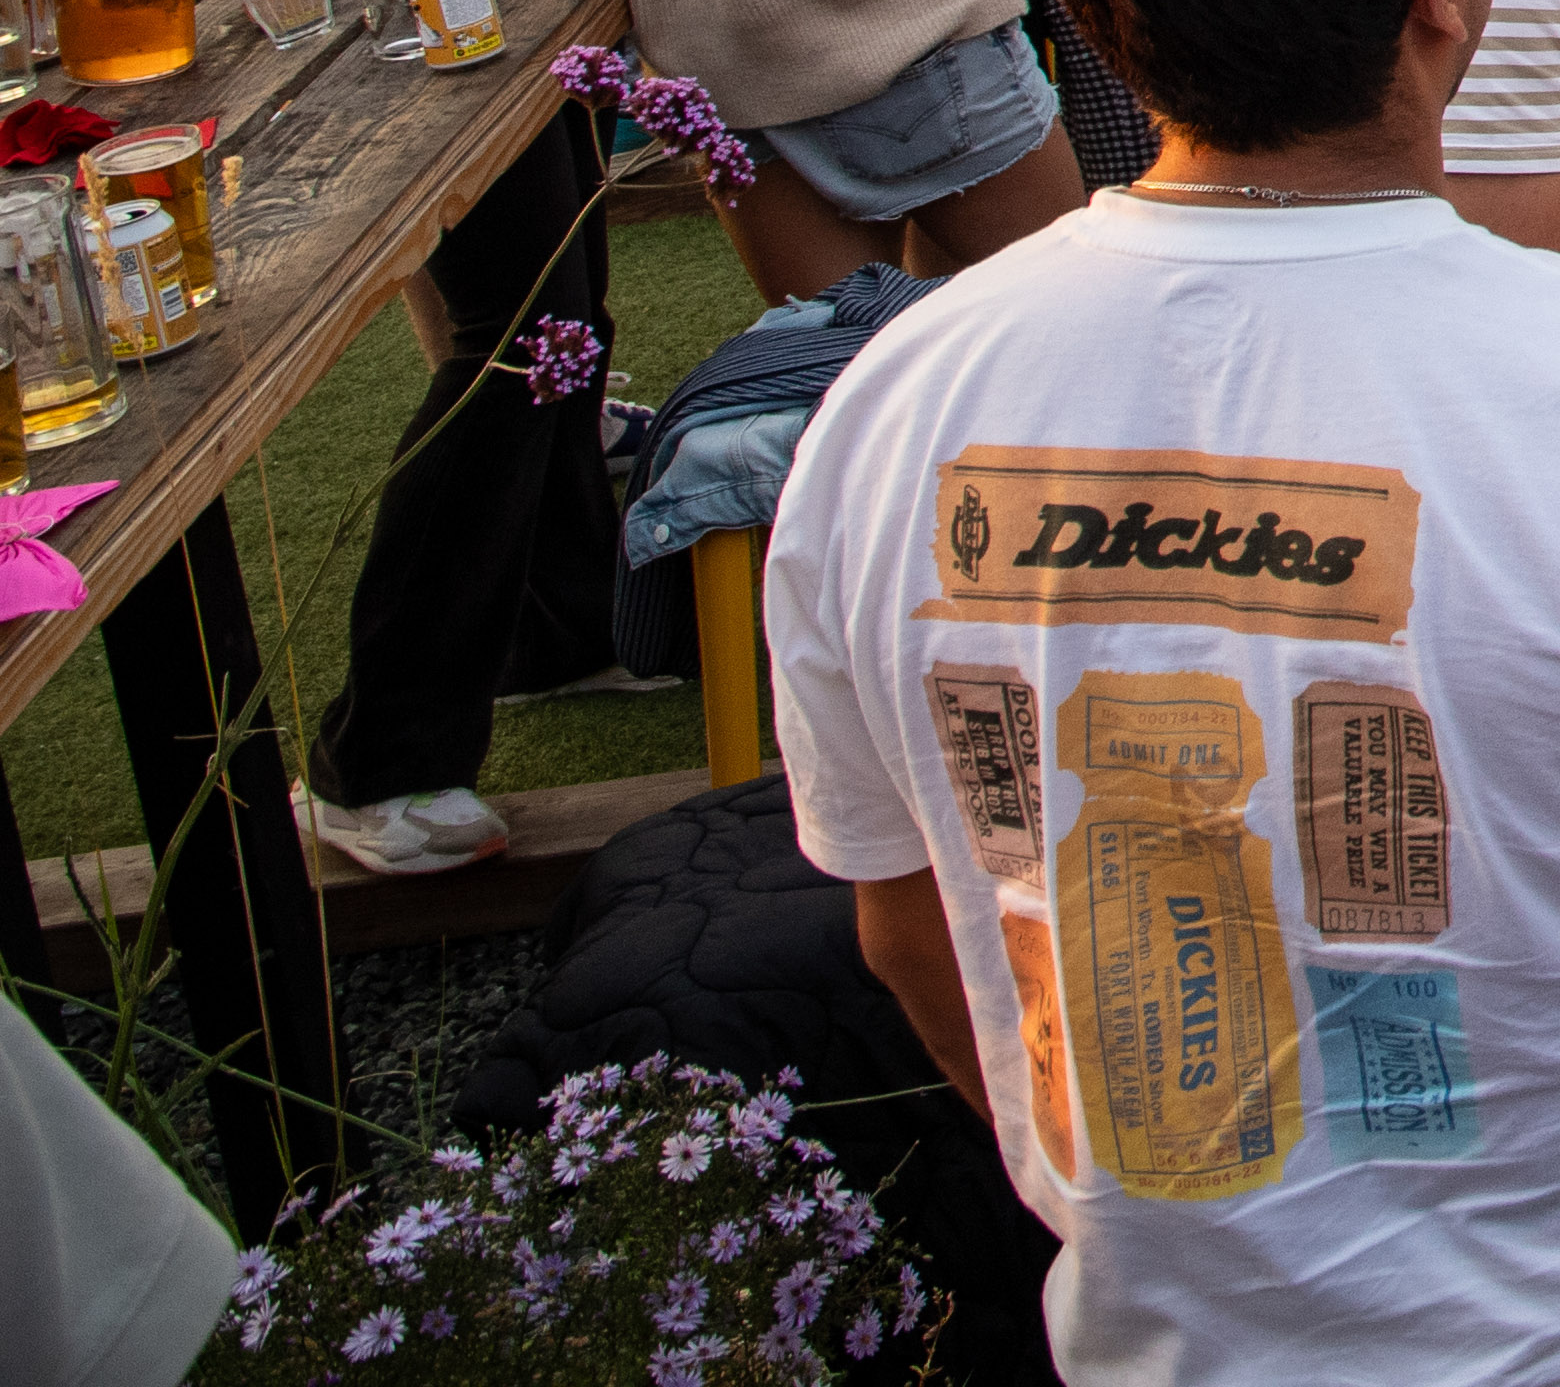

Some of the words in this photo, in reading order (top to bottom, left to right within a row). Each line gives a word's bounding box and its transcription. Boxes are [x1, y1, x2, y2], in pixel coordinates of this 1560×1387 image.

[1012, 502, 1367, 587] Dickies
[942, 691, 963, 720] AT
[1011, 688, 1040, 767] DOOR
[952, 729, 975, 771] THE
[968, 720, 990, 760] STUB
[1108, 739, 1169, 766] ADMIT
[1177, 742, 1225, 767] ONE
[1367, 714, 1387, 757] YOU
[1403, 712, 1431, 762] KEEP
[980, 765, 997, 780] IN
[985, 723, 1010, 771] DROP
[1001, 778, 1021, 819] THIS
[1344, 717, 1363, 826] VALUABLE
[1367, 768, 1387, 818] MAY
[965, 779, 993, 839] DOOR
[985, 784, 1003, 817] BOX
[1406, 774, 1439, 819] THIS
[1346, 834, 1367, 889] PRIZE
[1369, 829, 1389, 872] WIN
[1407, 833, 1440, 901] TICKET
[1135, 870, 1152, 905] Fort
[1373, 880, 1390, 894] A
[1109, 950, 1132, 1000] FORT
[1164, 895, 1220, 1093] DICKIES
[1392, 979, 1438, 998] 100
[1113, 1006, 1139, 1068] WORTH
[1142, 1000, 1165, 1076] RODEO
[1238, 1065, 1268, 1128] SINCE
[1371, 1018, 1429, 1133] ADMISSION
[1246, 1131, 1269, 1156] 22
